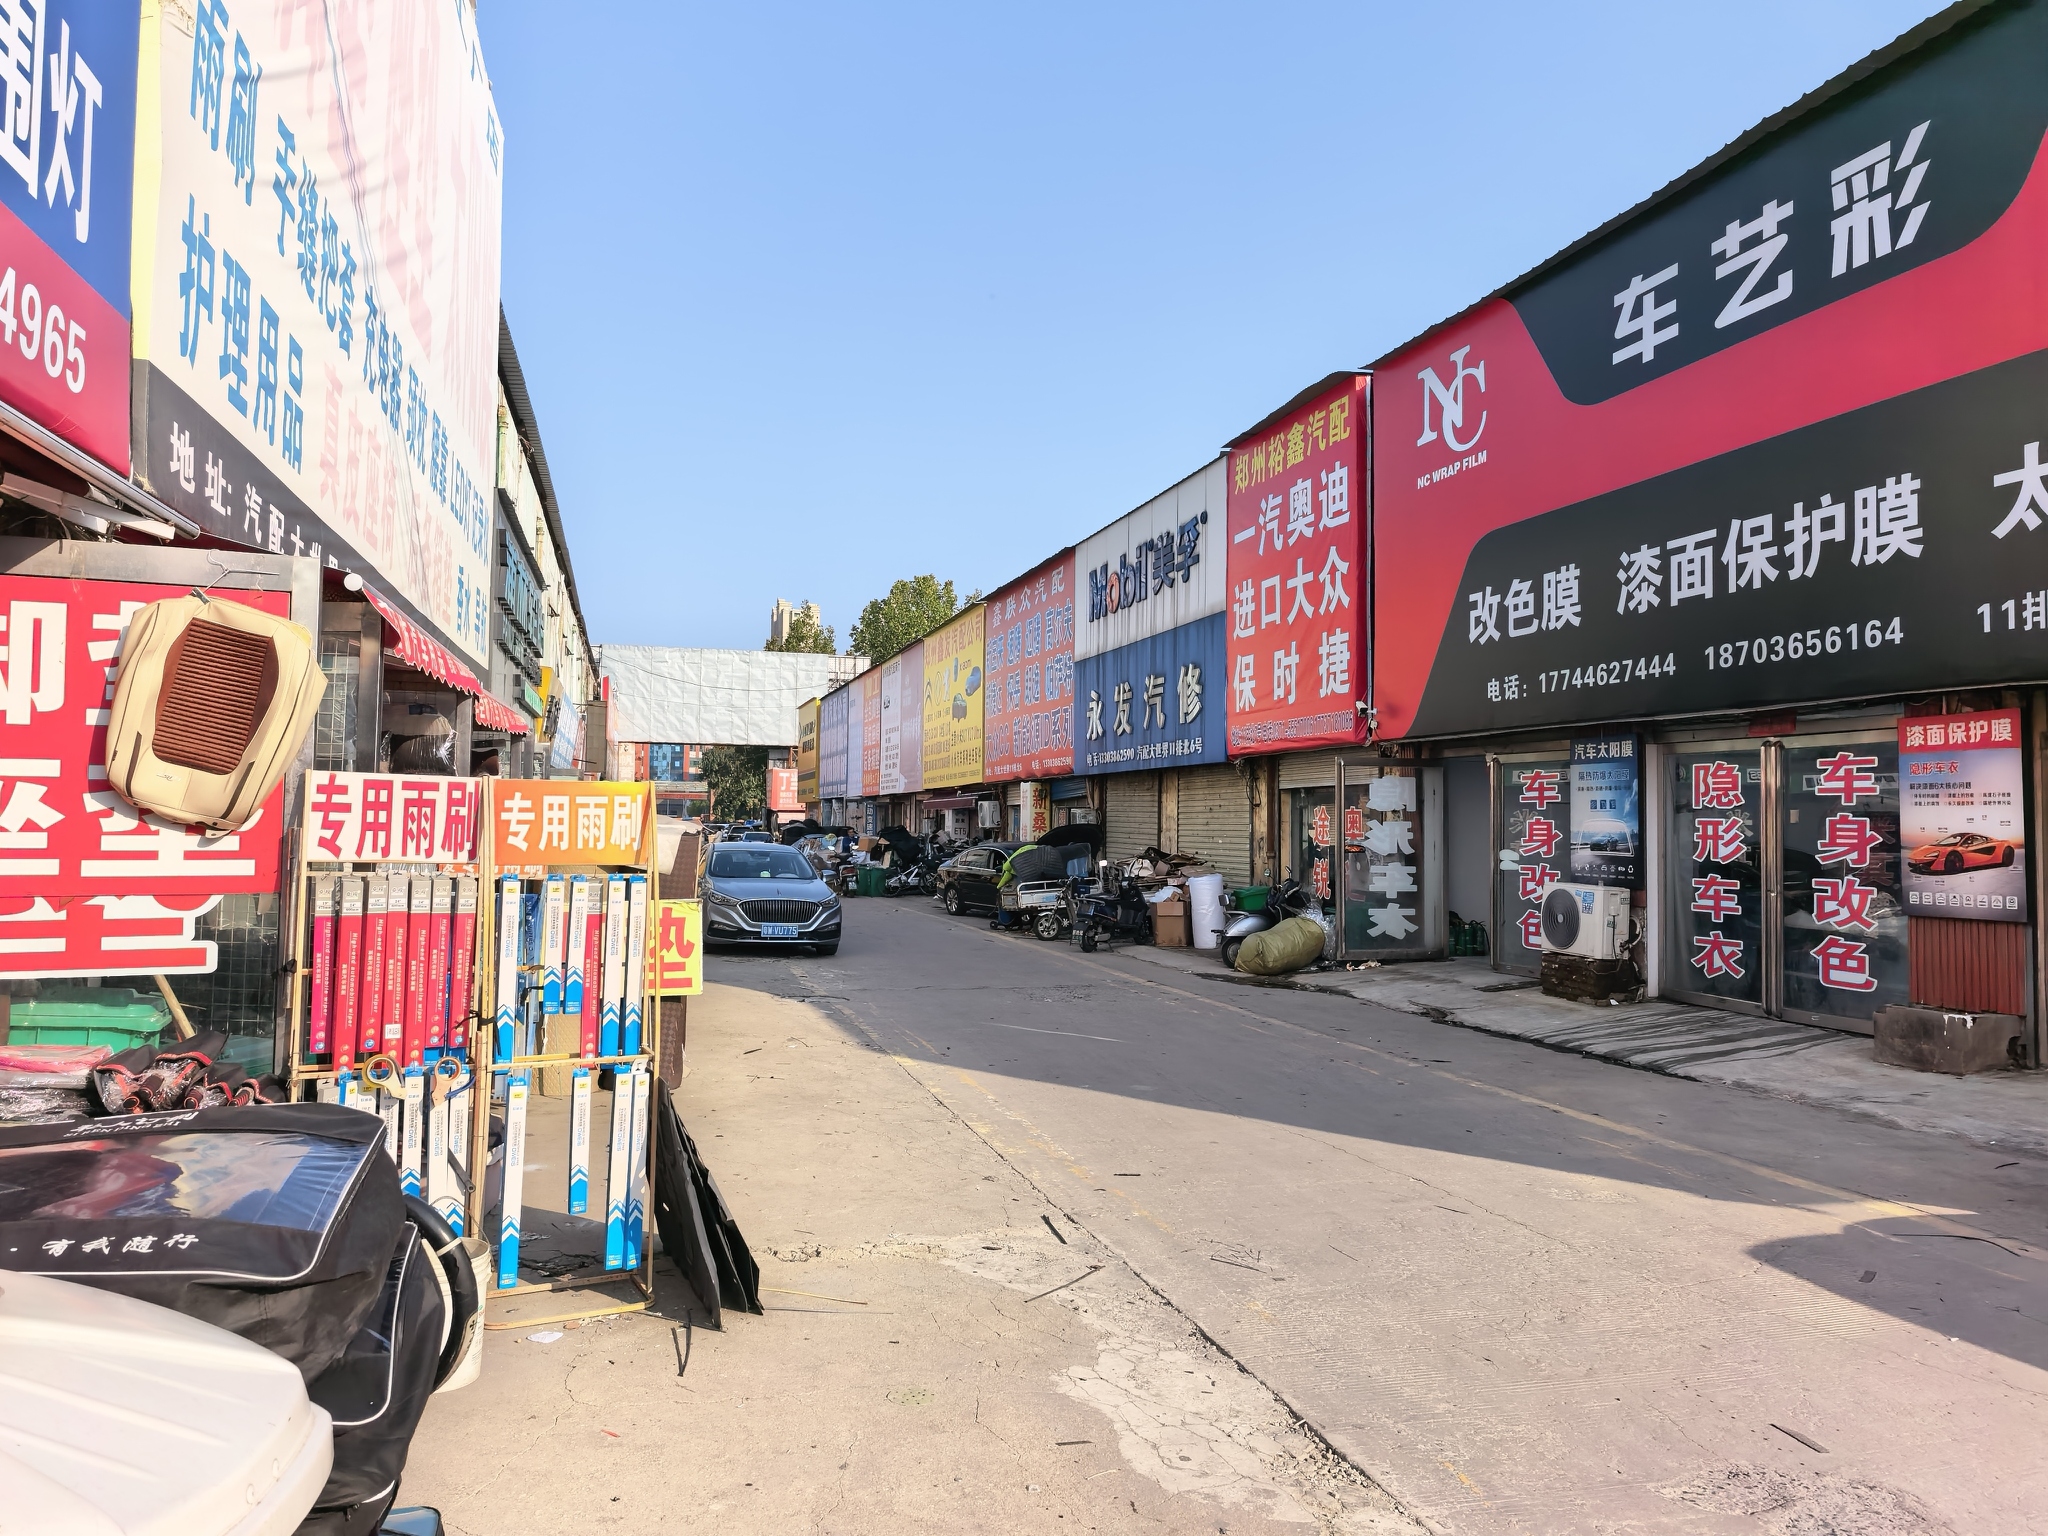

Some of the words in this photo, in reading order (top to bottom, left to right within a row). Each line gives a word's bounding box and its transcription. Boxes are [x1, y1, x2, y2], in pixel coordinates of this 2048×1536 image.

[1612, 119, 1932, 366] 车艺彩
[179, 193, 304, 475] 护理用品
[1235, 395, 1350, 495] 郑州裕鑫汽配
[1417, 473, 1431, 489] NC
[1432, 461, 1461, 484] WRAP
[1462, 449, 1488, 474] FILM
[1233, 461, 1350, 556] 一汽奥迪
[992, 564, 1065, 628] 鑫联众汽配
[1088, 541, 1148, 623] Mobil
[1152, 511, 1201, 596] 美孚
[1233, 546, 1350, 640] 进口大众
[1467, 563, 1582, 645] 改色膜
[1616, 472, 1924, 614] 漆面保护膜
[1233, 627, 1350, 713] 保时捷
[1538, 653, 1676, 694] 17744627444
[1704, 617, 1904, 671] 18703656164
[1086, 662, 1203, 741] 永发汽修
[1905, 718, 2013, 748] 漆面保护膜
[1574, 740, 1633, 760] 汽车太阳膜
[1909, 761, 1959, 776] 隐形车衣
[311, 773, 480, 860] 专用雨刷
[501, 791, 643, 853] 专用雨刷
[954, 827, 966, 835] ET5
[1313, 806, 1331, 899] 途锐
[1691, 760, 1749, 979] 隐形车衣
[1810, 752, 1883, 993] 车身改色
[350, 932, 358, 964] High-end
[376, 919, 384, 950] High-end
